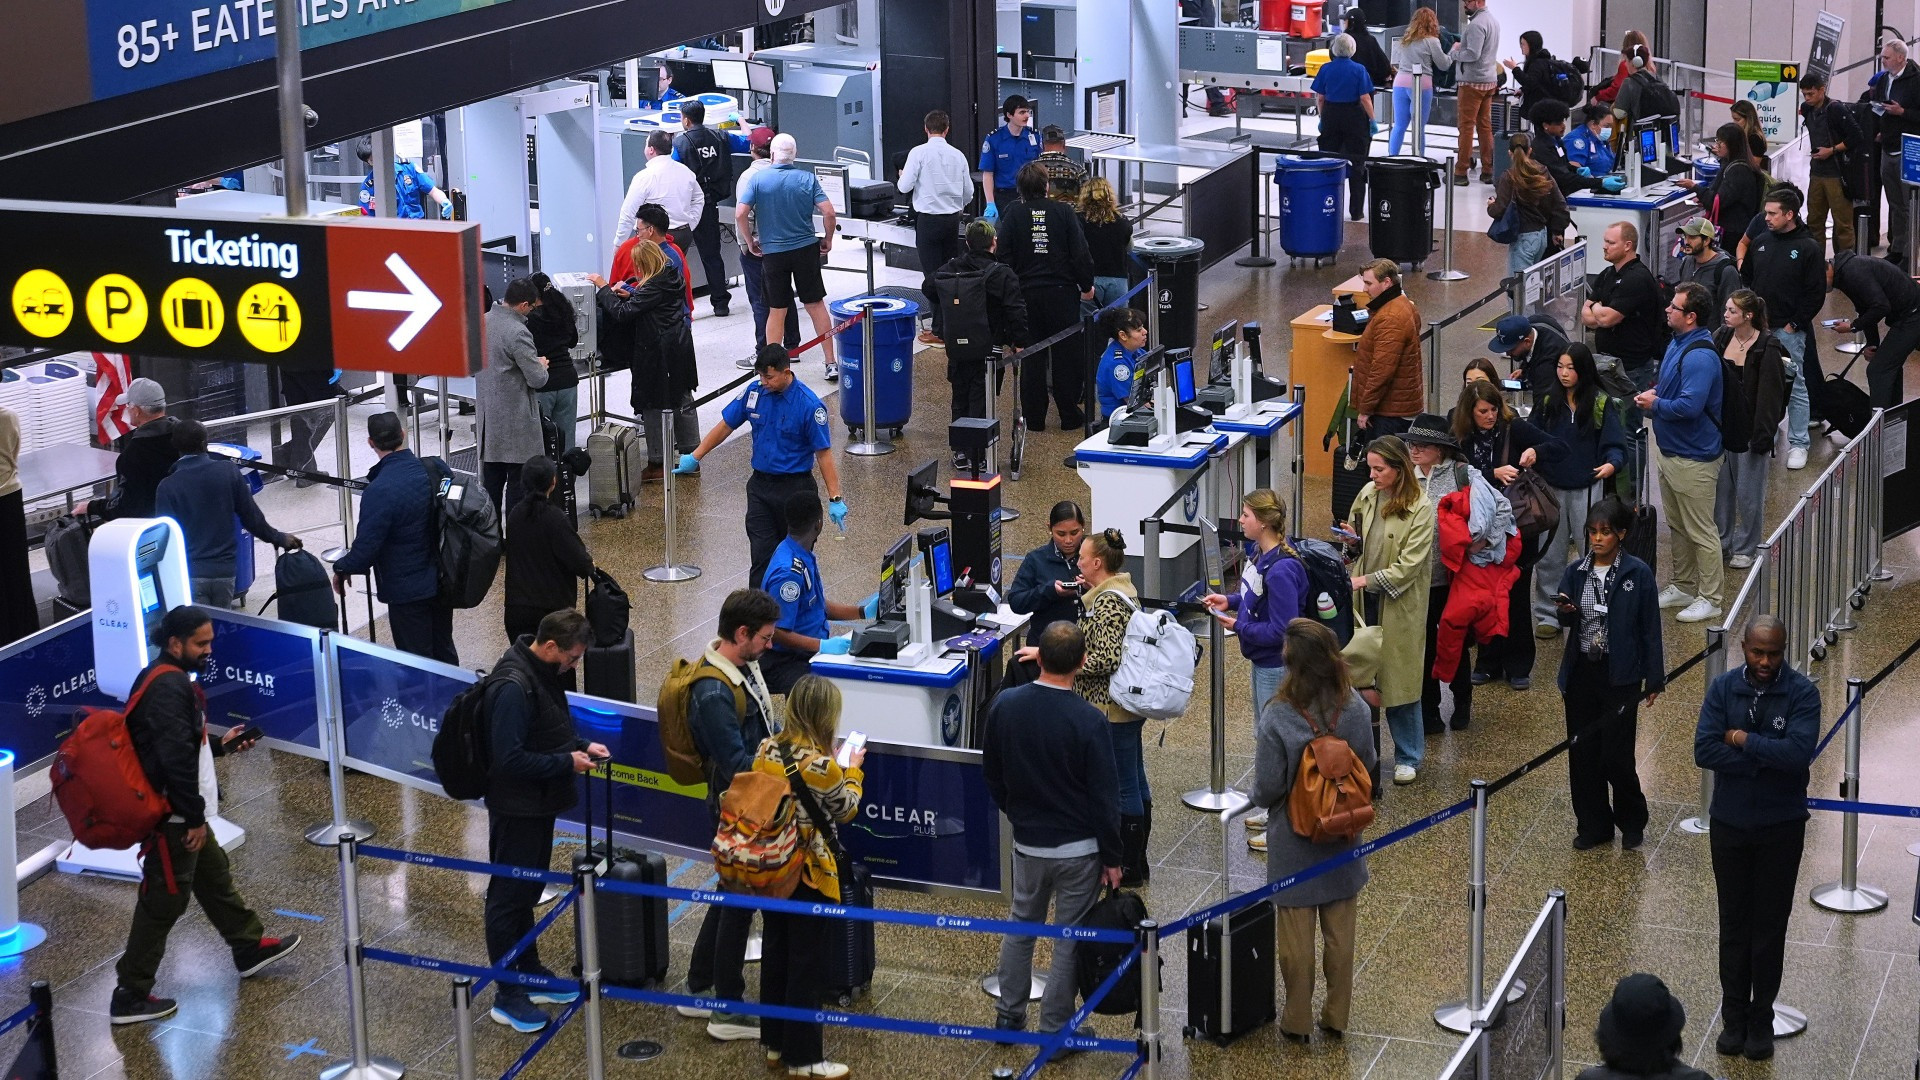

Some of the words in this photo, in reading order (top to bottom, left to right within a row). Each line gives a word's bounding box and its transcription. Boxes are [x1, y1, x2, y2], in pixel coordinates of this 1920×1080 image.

[117, 19, 179, 68] 85+
[191, 0, 348, 52] EATEIES
[1756, 103, 1777, 112] Pour
[1760, 114, 1782, 124] quids
[1763, 127, 1778, 135] ere
[164, 228, 300, 279] Ticketing
[286, 468, 299, 477] SEA
[343, 480, 356, 488] SEA
[99, 618, 129, 630] CLEAR
[225, 665, 275, 689] CLEAR
[52, 668, 97, 698] CLEAR
[258, 687, 275, 697] PLUS
[411, 712, 438, 732] CLE
[595, 764, 635, 781] Wecome
[637, 773, 659, 786] Back
[865, 803, 937, 826] CLEAR
[913, 825, 936, 836] PLUS
[1360, 843, 1376, 855] CLEAR
[414, 855, 434, 863] CLEAR
[863, 856, 898, 865] clearme.com
[522, 870, 542, 878] CLEAR
[1280, 876, 1296, 888] CLEAR
[702, 893, 724, 902] CLEAR
[823, 907, 846, 915] CLEAR
[1195, 911, 1211, 922] CLEAR
[948, 919, 971, 927] CLEAR
[1074, 930, 1097, 938] CLEAR
[706, 1001, 728, 1009] CLEAR
[827, 1015, 848, 1023] CLEAR
[950, 1028, 972, 1036] CLEAR
